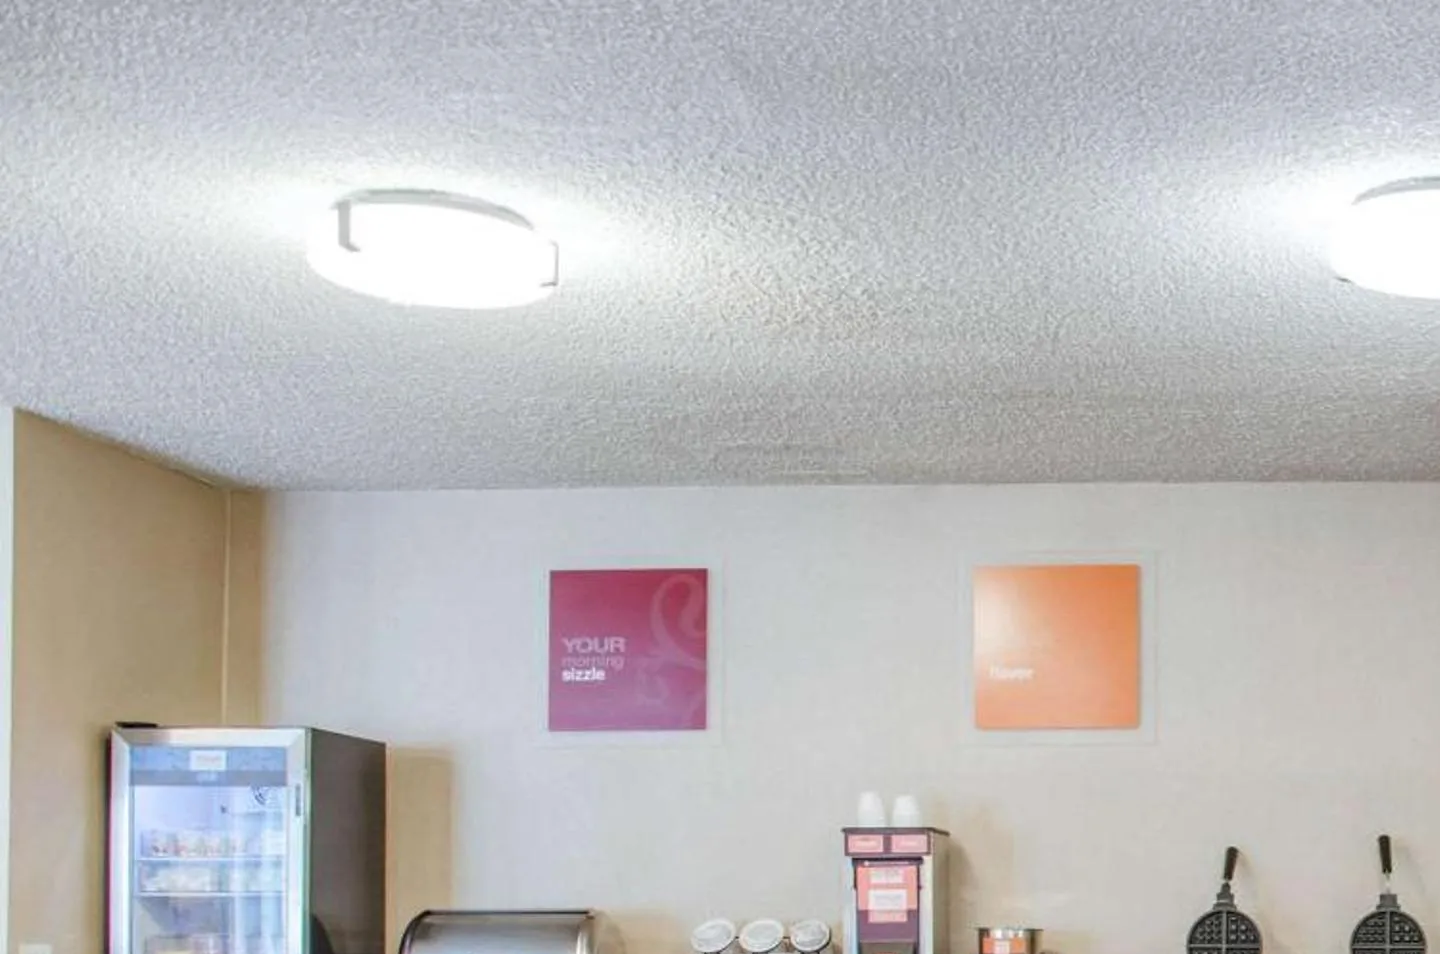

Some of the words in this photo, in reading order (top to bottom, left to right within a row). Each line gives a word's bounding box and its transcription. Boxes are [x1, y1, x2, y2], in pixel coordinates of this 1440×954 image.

[562, 636, 626, 653] YOUR
[562, 655, 625, 671] morning
[562, 667, 606, 682] sizzle
